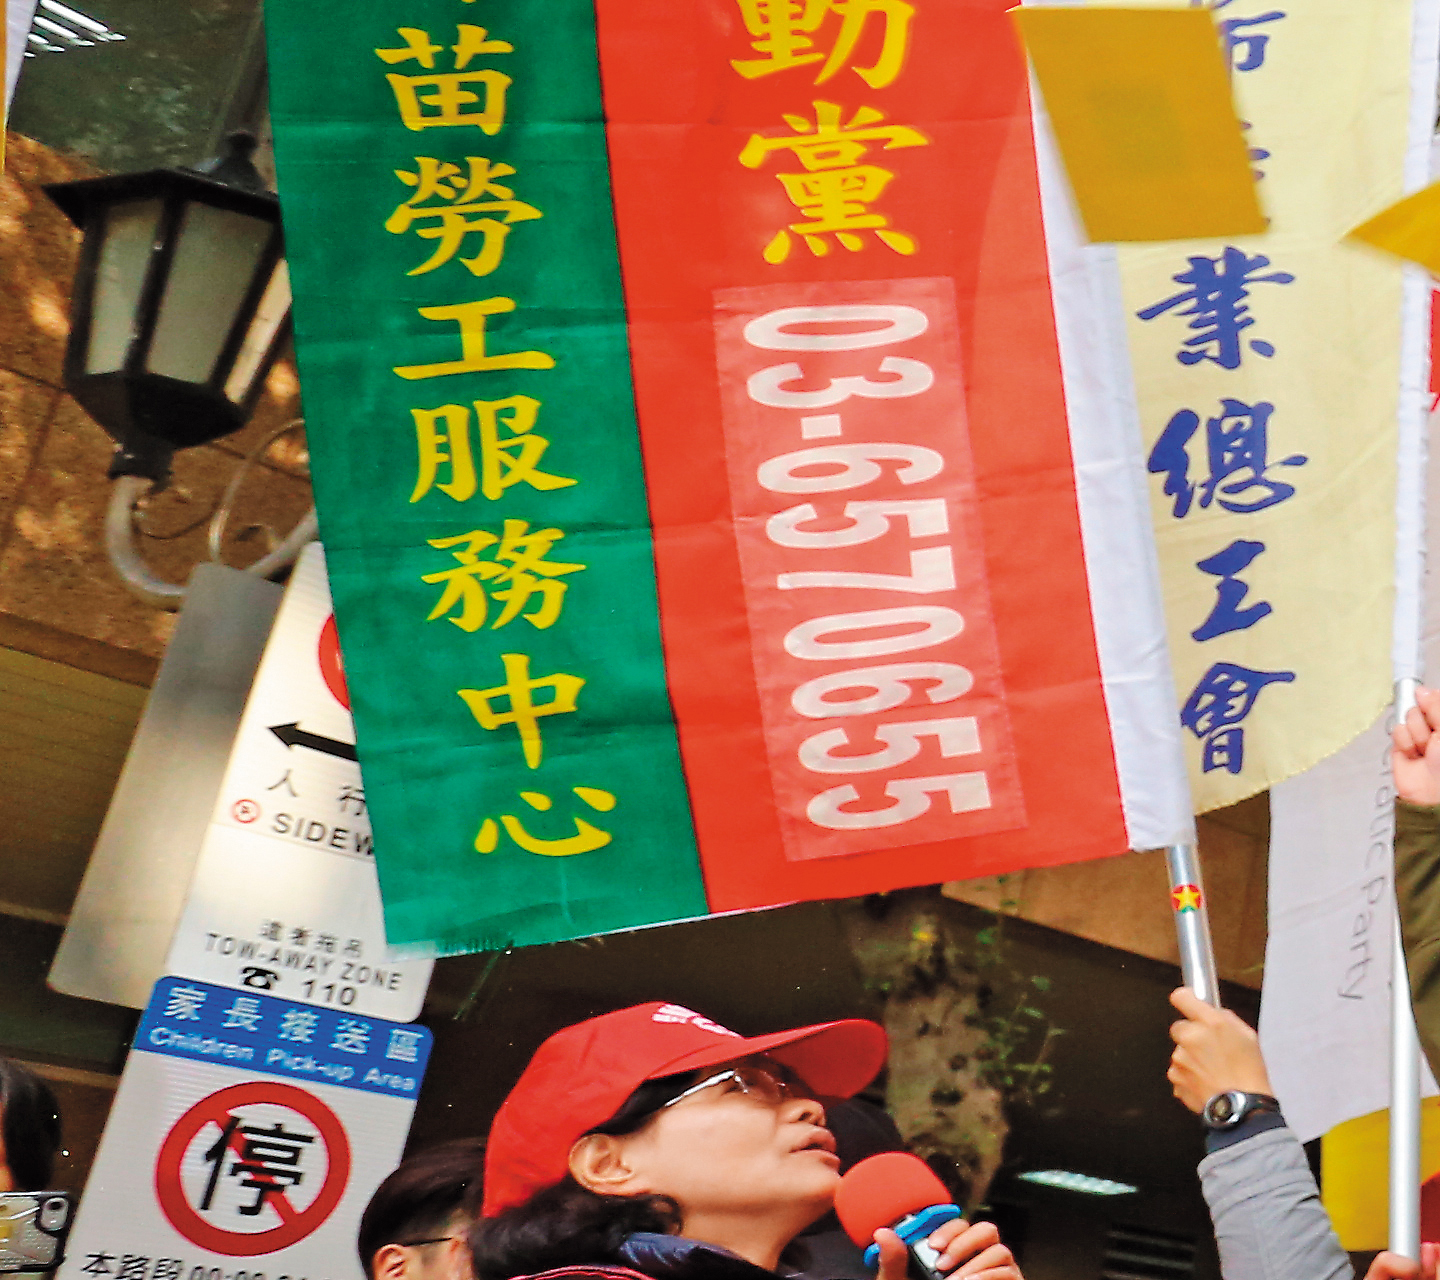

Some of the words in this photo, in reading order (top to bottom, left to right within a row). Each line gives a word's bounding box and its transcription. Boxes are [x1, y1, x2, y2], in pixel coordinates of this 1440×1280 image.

[743, 303, 991, 831] 03-6570655
[205, 932, 335, 974] TOW-AWAY
[340, 962, 403, 992] ZONE
[1338, 874, 1385, 1001] Party
[163, 984, 425, 1064] 家長接送區
[303, 979, 357, 1006] 110
[149, 1026, 255, 1061] Children
[265, 1047, 355, 1082] Pick-up
[362, 1066, 417, 1092] Area
[201, 1116, 314, 1216] 停
